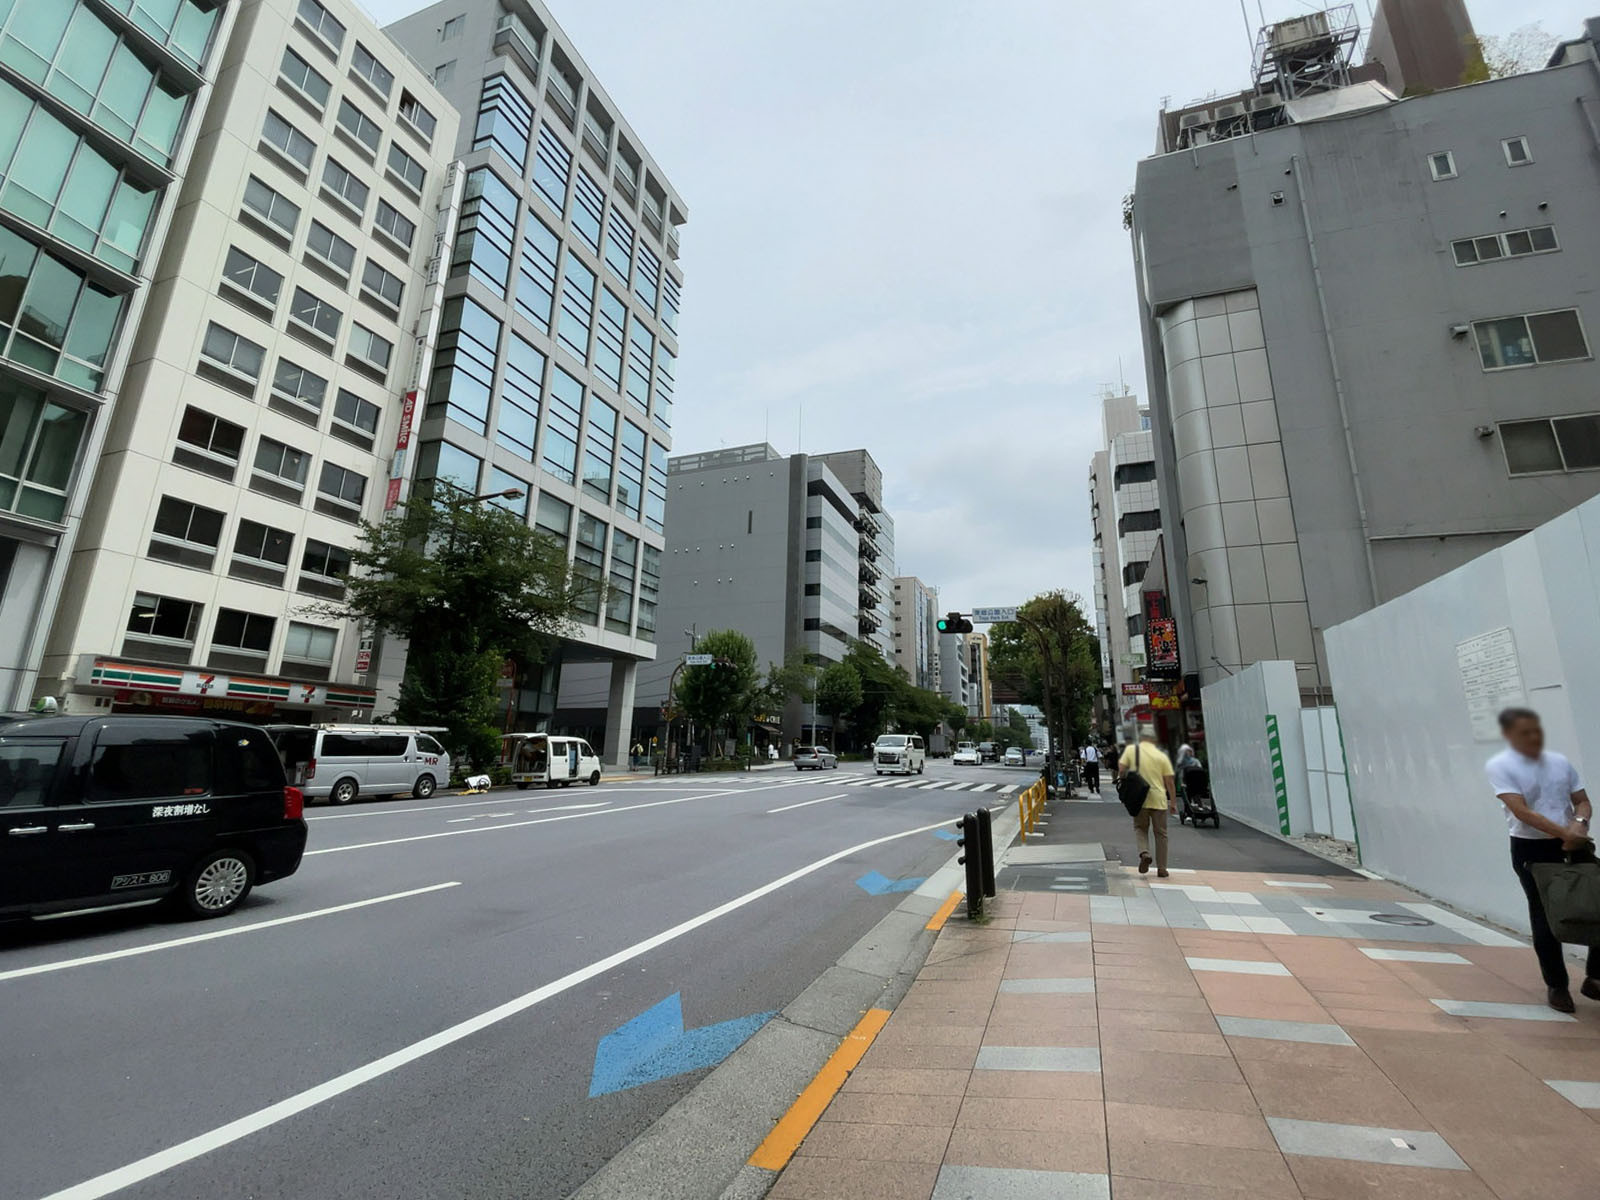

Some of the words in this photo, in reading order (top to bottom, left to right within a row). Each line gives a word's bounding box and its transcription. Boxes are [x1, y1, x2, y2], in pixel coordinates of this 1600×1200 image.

[424, 757, 439, 766] MR
[151, 803, 211, 818] 深夜割増なし
